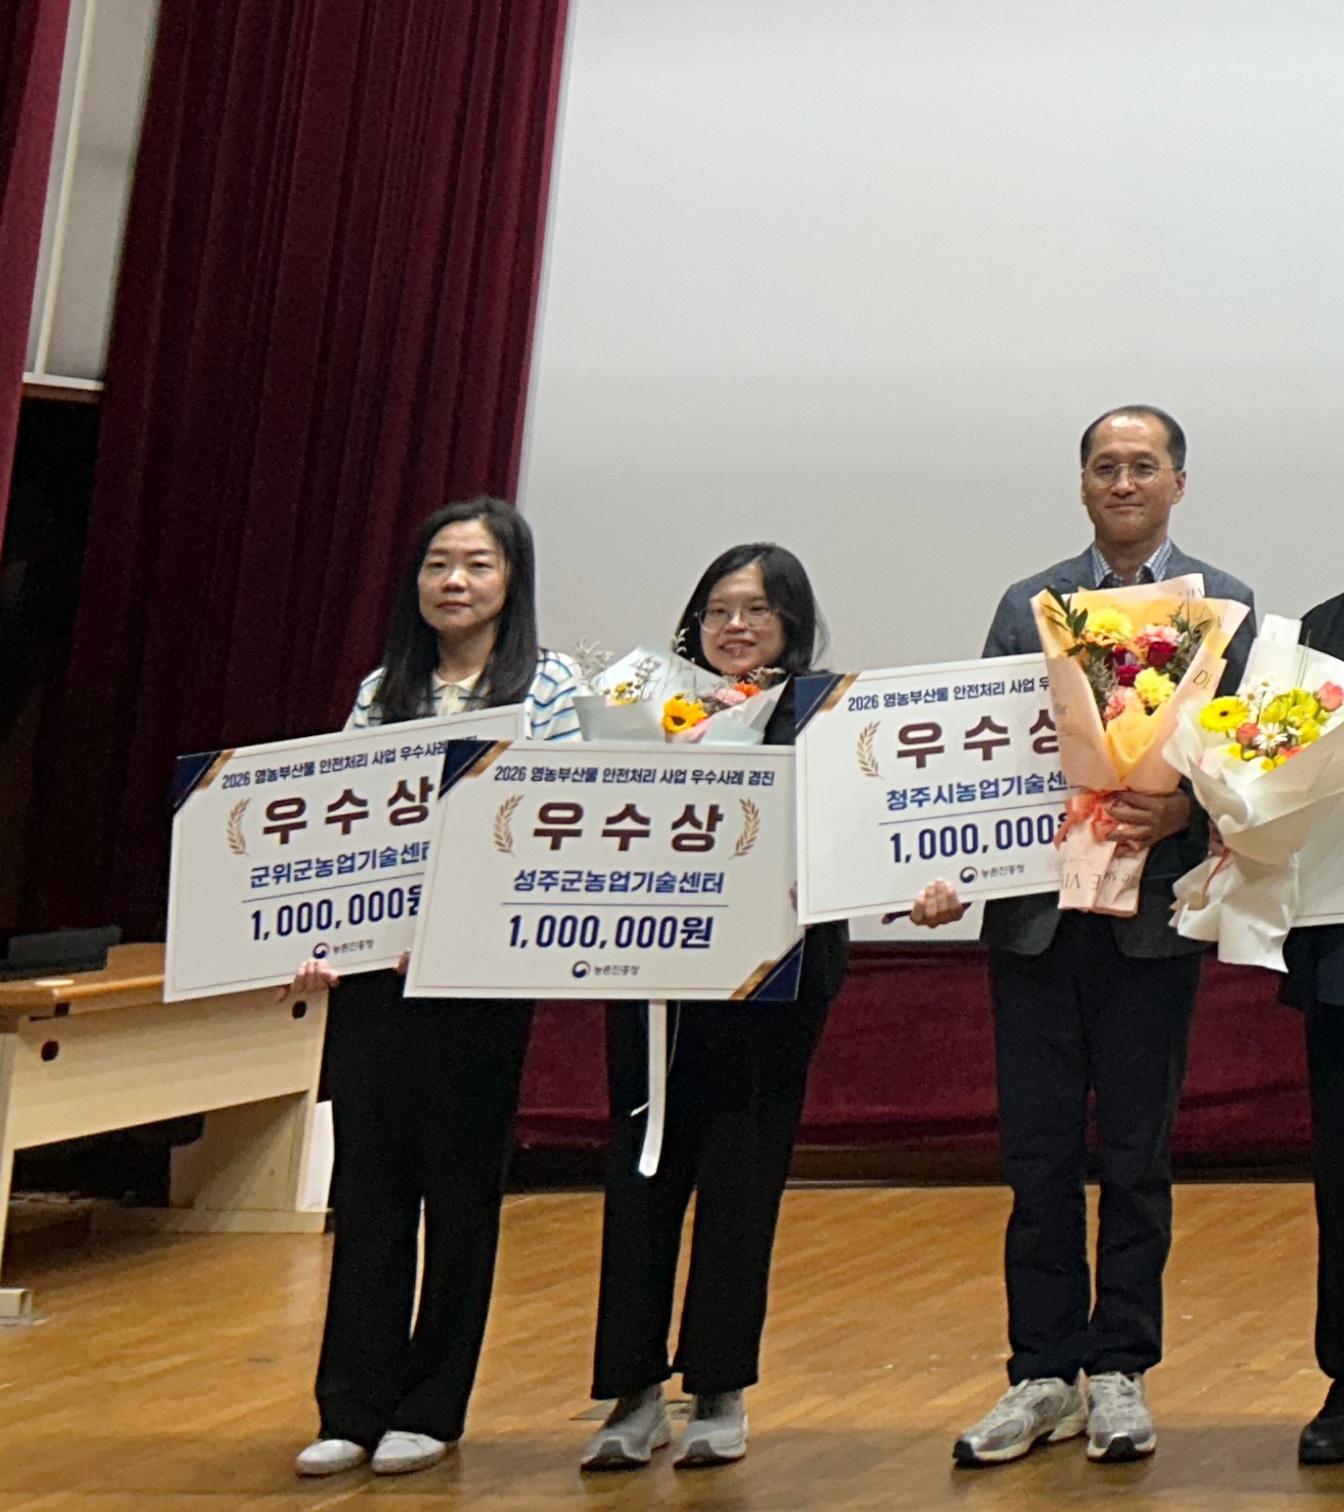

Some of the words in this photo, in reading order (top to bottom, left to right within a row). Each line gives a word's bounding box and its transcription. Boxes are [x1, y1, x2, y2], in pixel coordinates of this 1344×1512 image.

[848, 696, 879, 711] 2026
[953, 681, 1005, 700] 안전처리
[1009, 679, 1035, 694] 사업
[222, 771, 251, 789] 2026
[320, 755, 368, 774] 안전처리
[372, 749, 396, 765] 사업
[494, 766, 526, 781] 2026
[602, 768, 656, 784] 안전처리
[660, 769, 686, 785] 사업
[690, 770, 743, 786] 우수사례
[513, 870, 725, 895] 성주군농업기술센터
[509, 915, 713, 949] 1,000,000원
